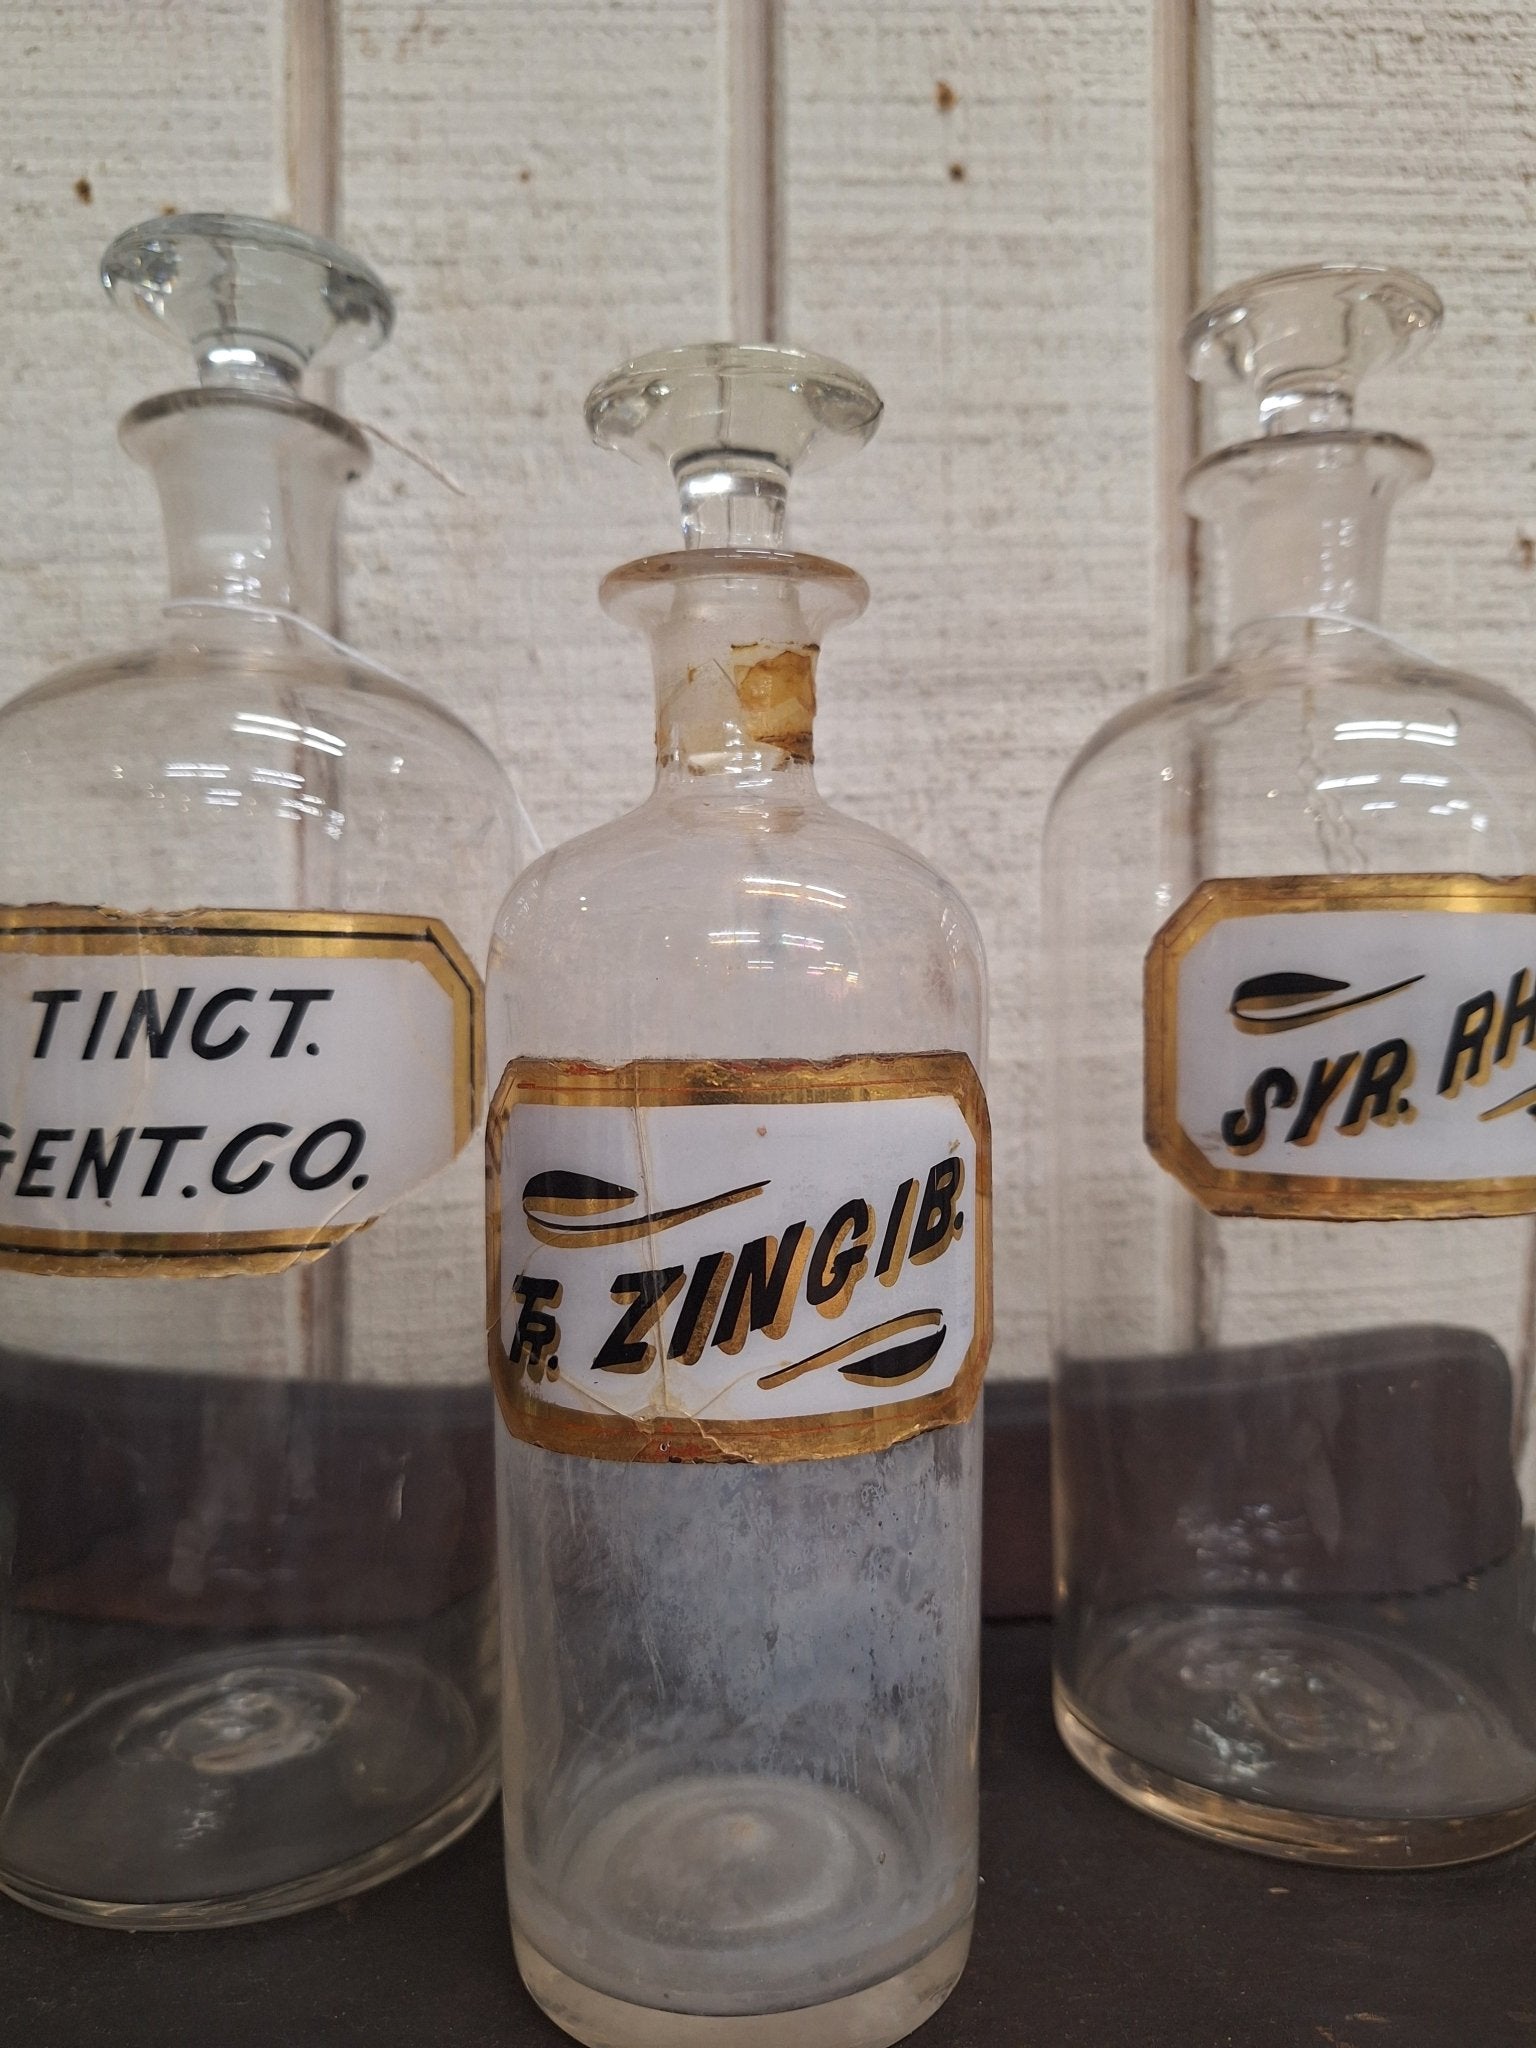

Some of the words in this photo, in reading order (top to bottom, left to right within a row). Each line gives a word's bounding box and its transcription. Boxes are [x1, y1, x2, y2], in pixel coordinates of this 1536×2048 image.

[32, 987, 335, 1060] TINCT.
[1221, 1037, 1418, 1156] SYR.
[0, 1118, 369, 1199] ENT.CO.
[591, 1156, 966, 1375] ZINGIB.
